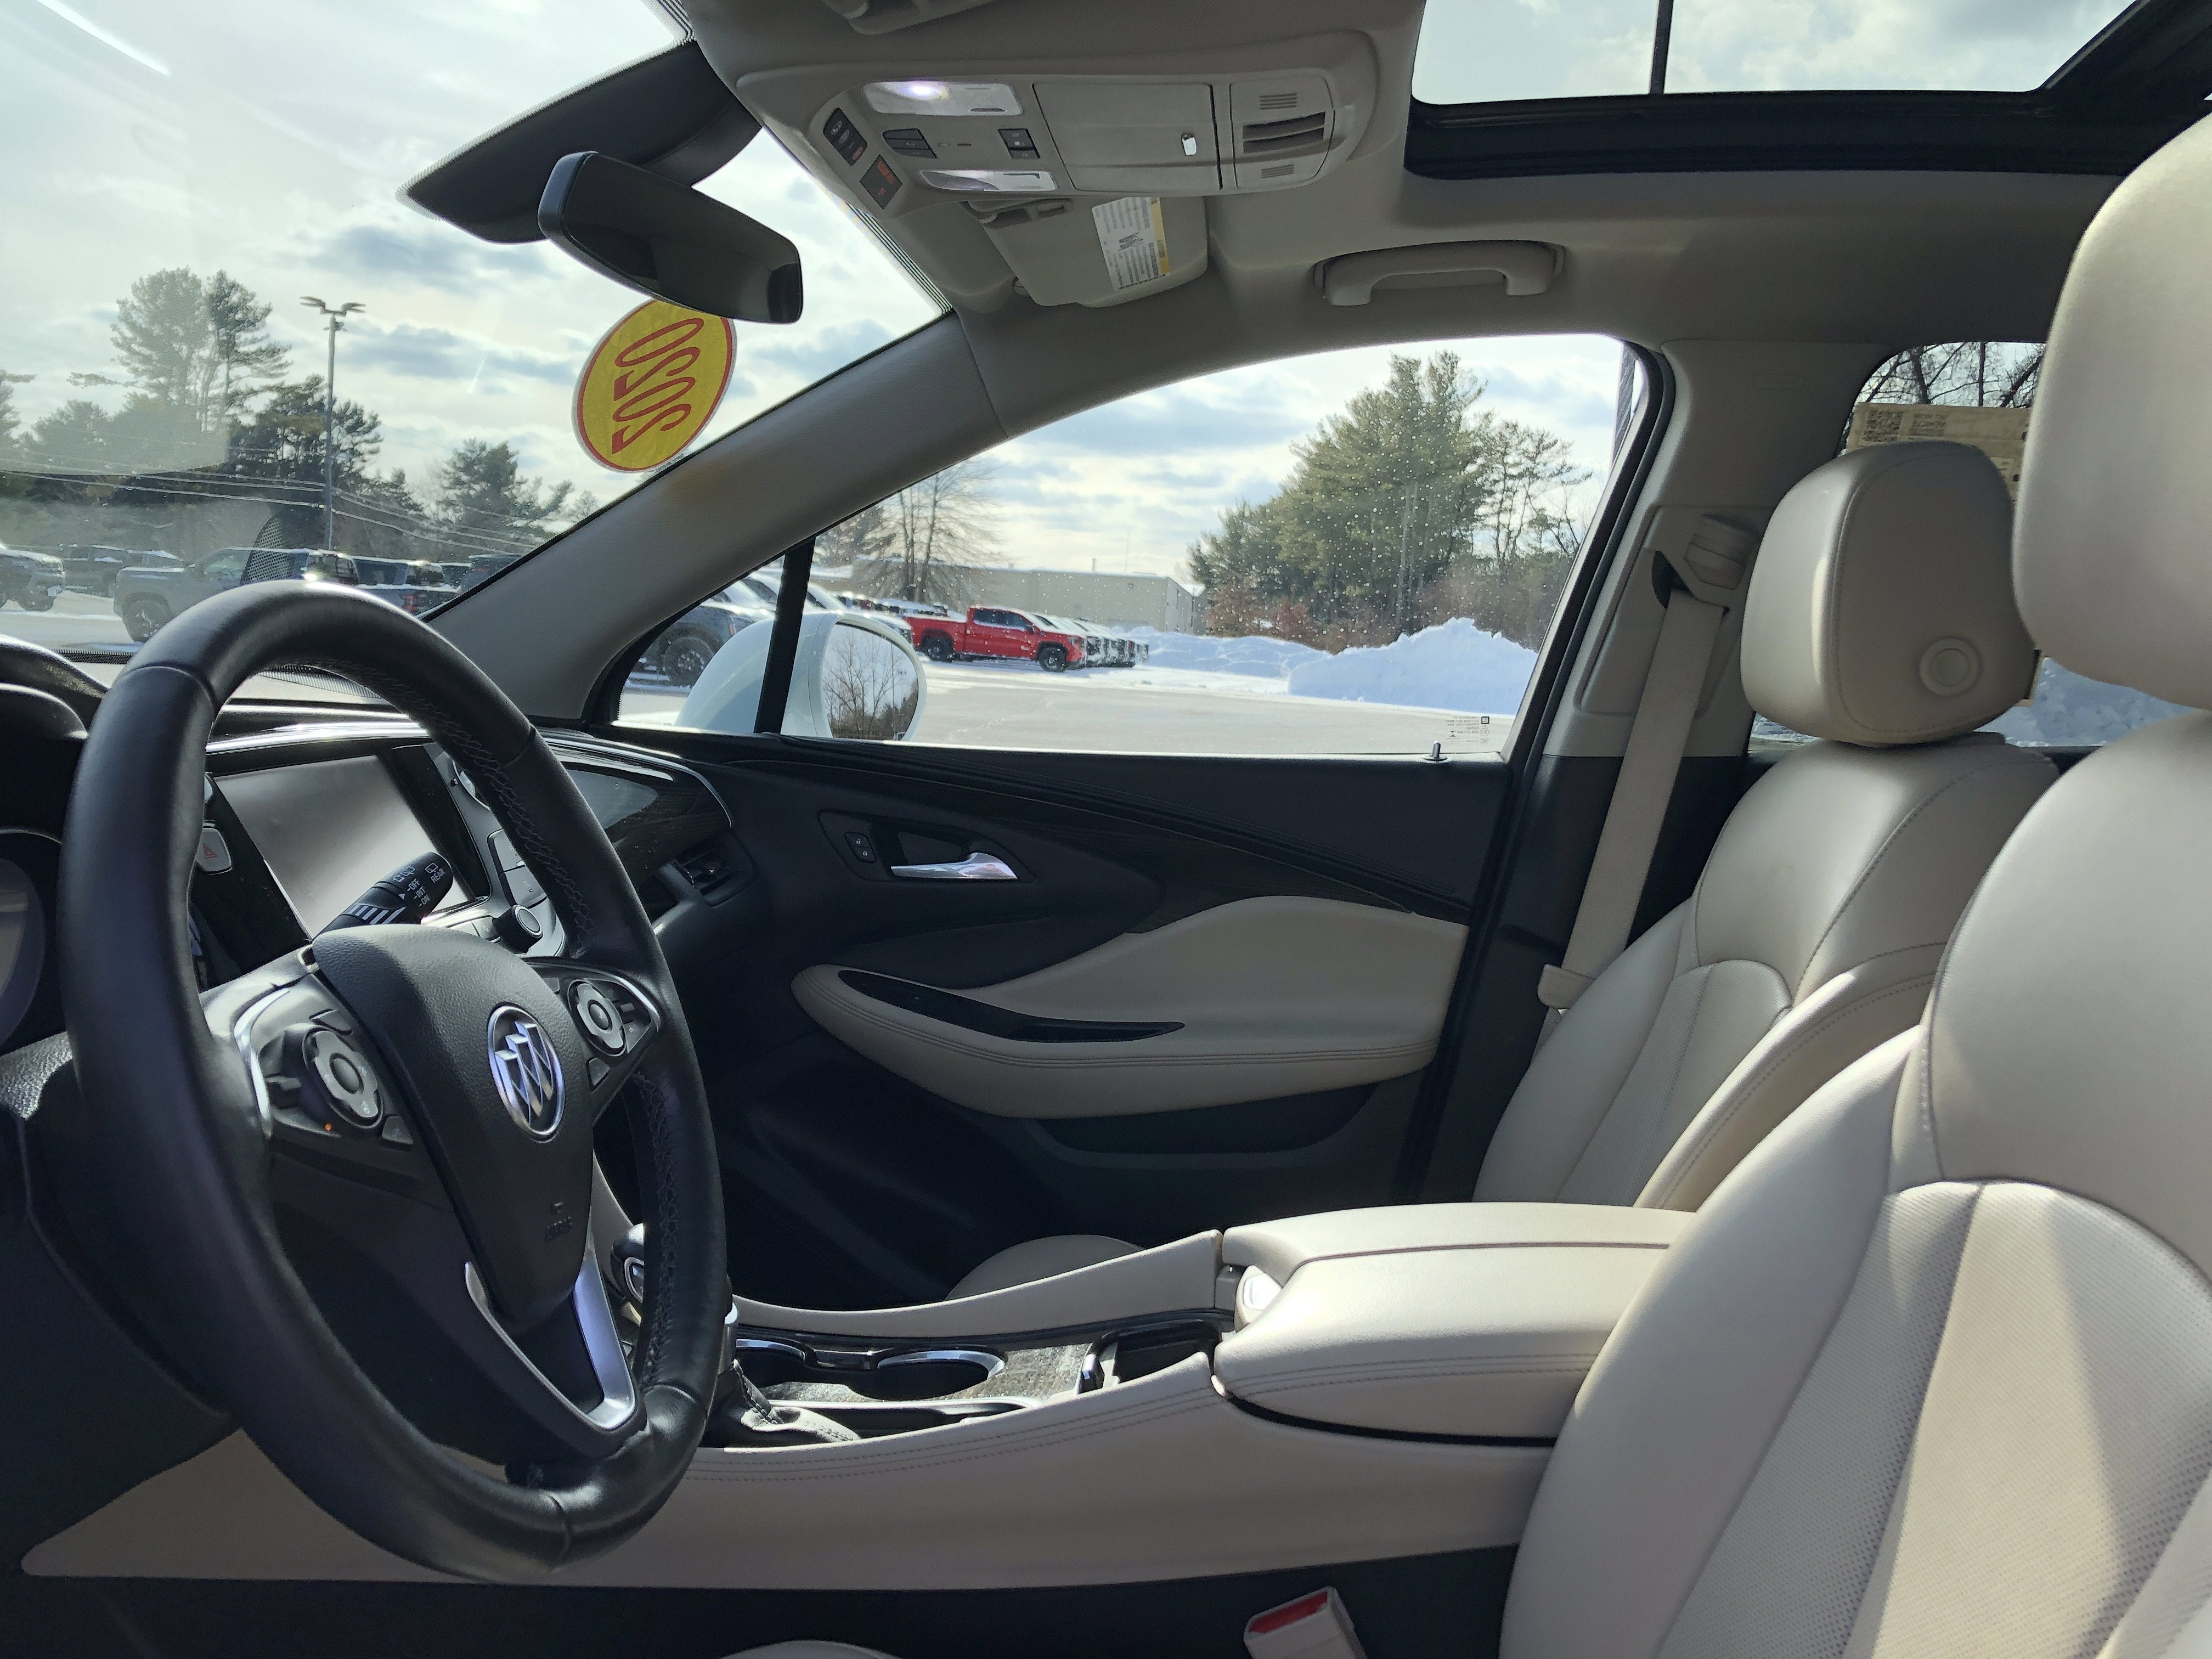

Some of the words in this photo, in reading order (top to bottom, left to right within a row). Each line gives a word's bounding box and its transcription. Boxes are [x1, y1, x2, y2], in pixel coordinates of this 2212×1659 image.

[430, 868, 446, 884] REAR
[408, 878, 420, 890] OFF
[415, 886, 426, 898] INT
[421, 894, 430, 905] ON
